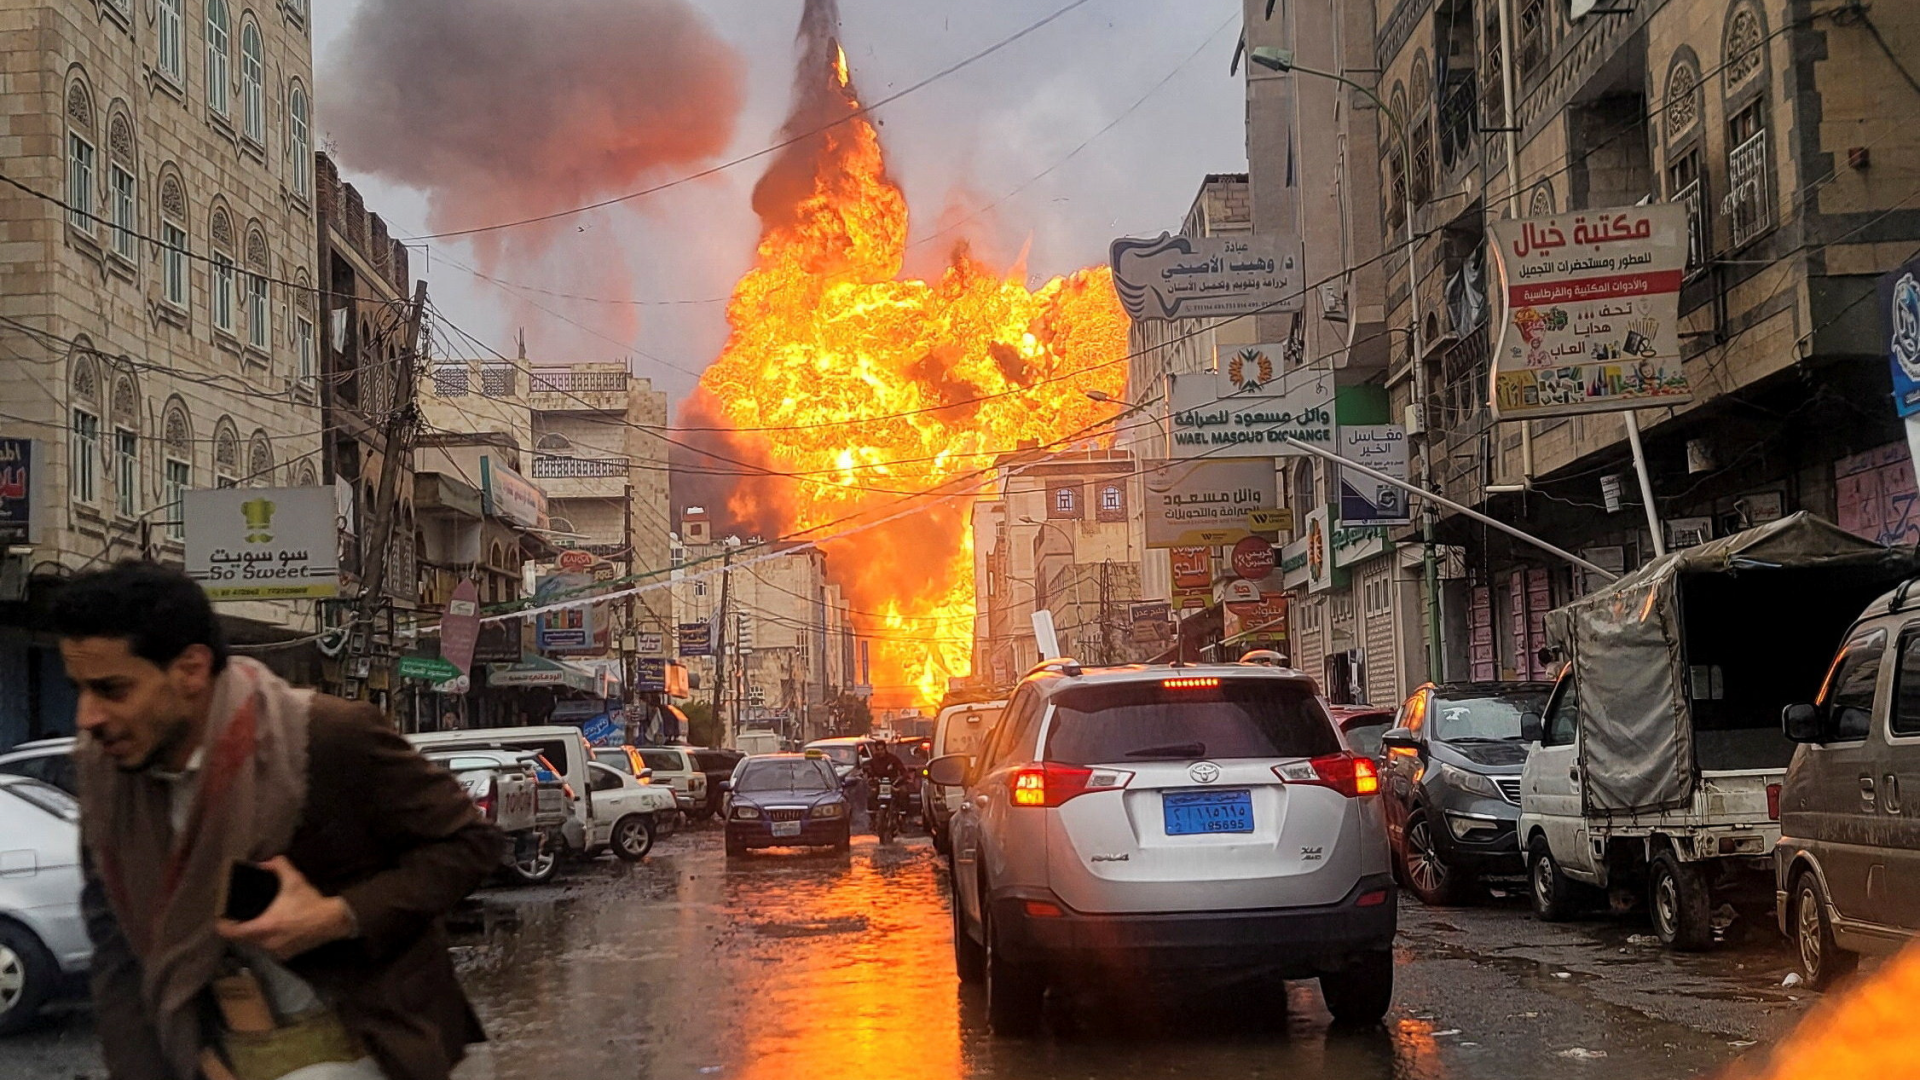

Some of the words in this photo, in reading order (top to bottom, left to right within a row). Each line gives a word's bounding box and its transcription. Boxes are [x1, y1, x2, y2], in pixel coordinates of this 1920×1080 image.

[1513, 219, 1566, 257] خيال
[1573, 213, 1650, 251] مكتبة
[1224, 241, 1249, 255] عيادة
[1161, 253, 1224, 283] الأصبحي
[1229, 257, 1275, 276] وهيب
[1557, 257, 1615, 275] ومستحضرات
[1618, 252, 1652, 270] للعطور
[1519, 261, 1555, 279] التجميل
[1524, 287, 1573, 301] والقرطاسية
[1574, 282, 1610, 297] المكتبية
[1612, 279, 1648, 293] والأدوات
[1598, 302, 1632, 317] تحف
[1573, 322, 1611, 336] هدايا
[1550, 341, 1586, 360] العاب
[1174, 409, 1229, 429] للصرافة
[1234, 411, 1291, 427] مسعود
[1296, 407, 1330, 426] وائل
[1174, 432, 1209, 446] WAEL
[1211, 430, 1264, 445] MASOUD
[1266, 428, 1331, 443] EXCHANGE
[1349, 428, 1403, 445] مغاسل
[1360, 442, 1391, 457] الخير
[1163, 491, 1229, 507] مسعود
[1233, 488, 1262, 504] وائل
[1164, 507, 1217, 520] والتحويلات
[210, 548, 274, 568] سويت
[279, 548, 309, 568] سو
[209, 565, 236, 581] So
[243, 564, 309, 580] Sweet
